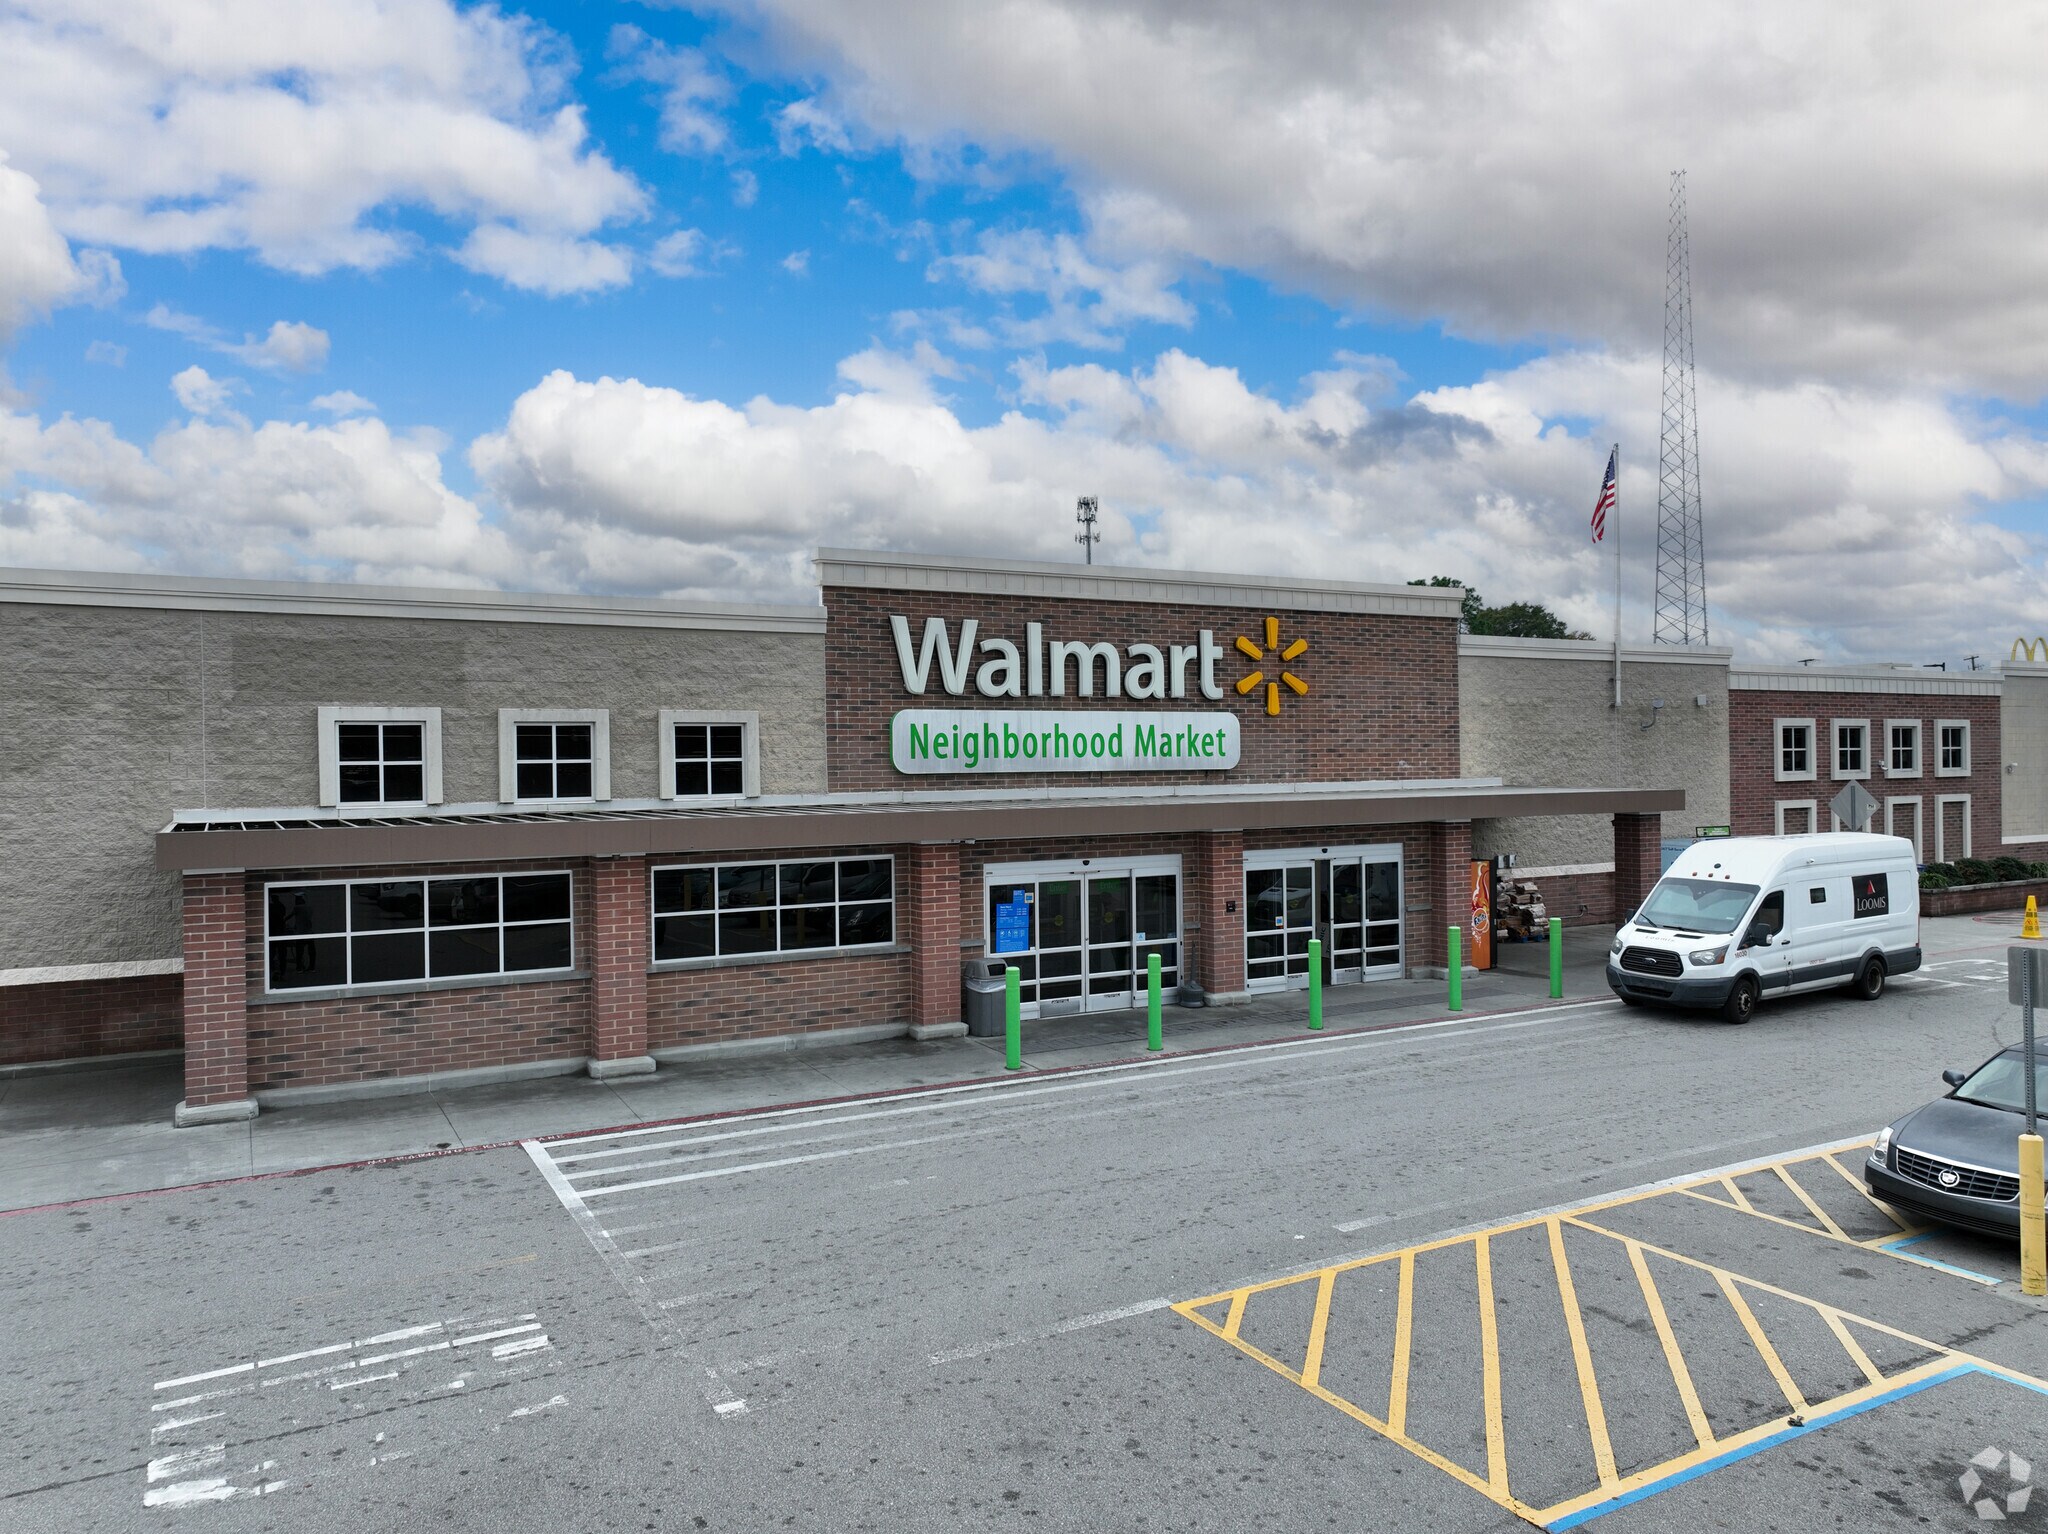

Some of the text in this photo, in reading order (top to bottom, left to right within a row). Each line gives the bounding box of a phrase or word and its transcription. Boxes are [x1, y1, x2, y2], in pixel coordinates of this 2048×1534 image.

[889, 615, 1223, 700] Walmart
[909, 722, 1227, 768] Neighborhood Market
[1856, 896, 1886, 912] LOOMIS
